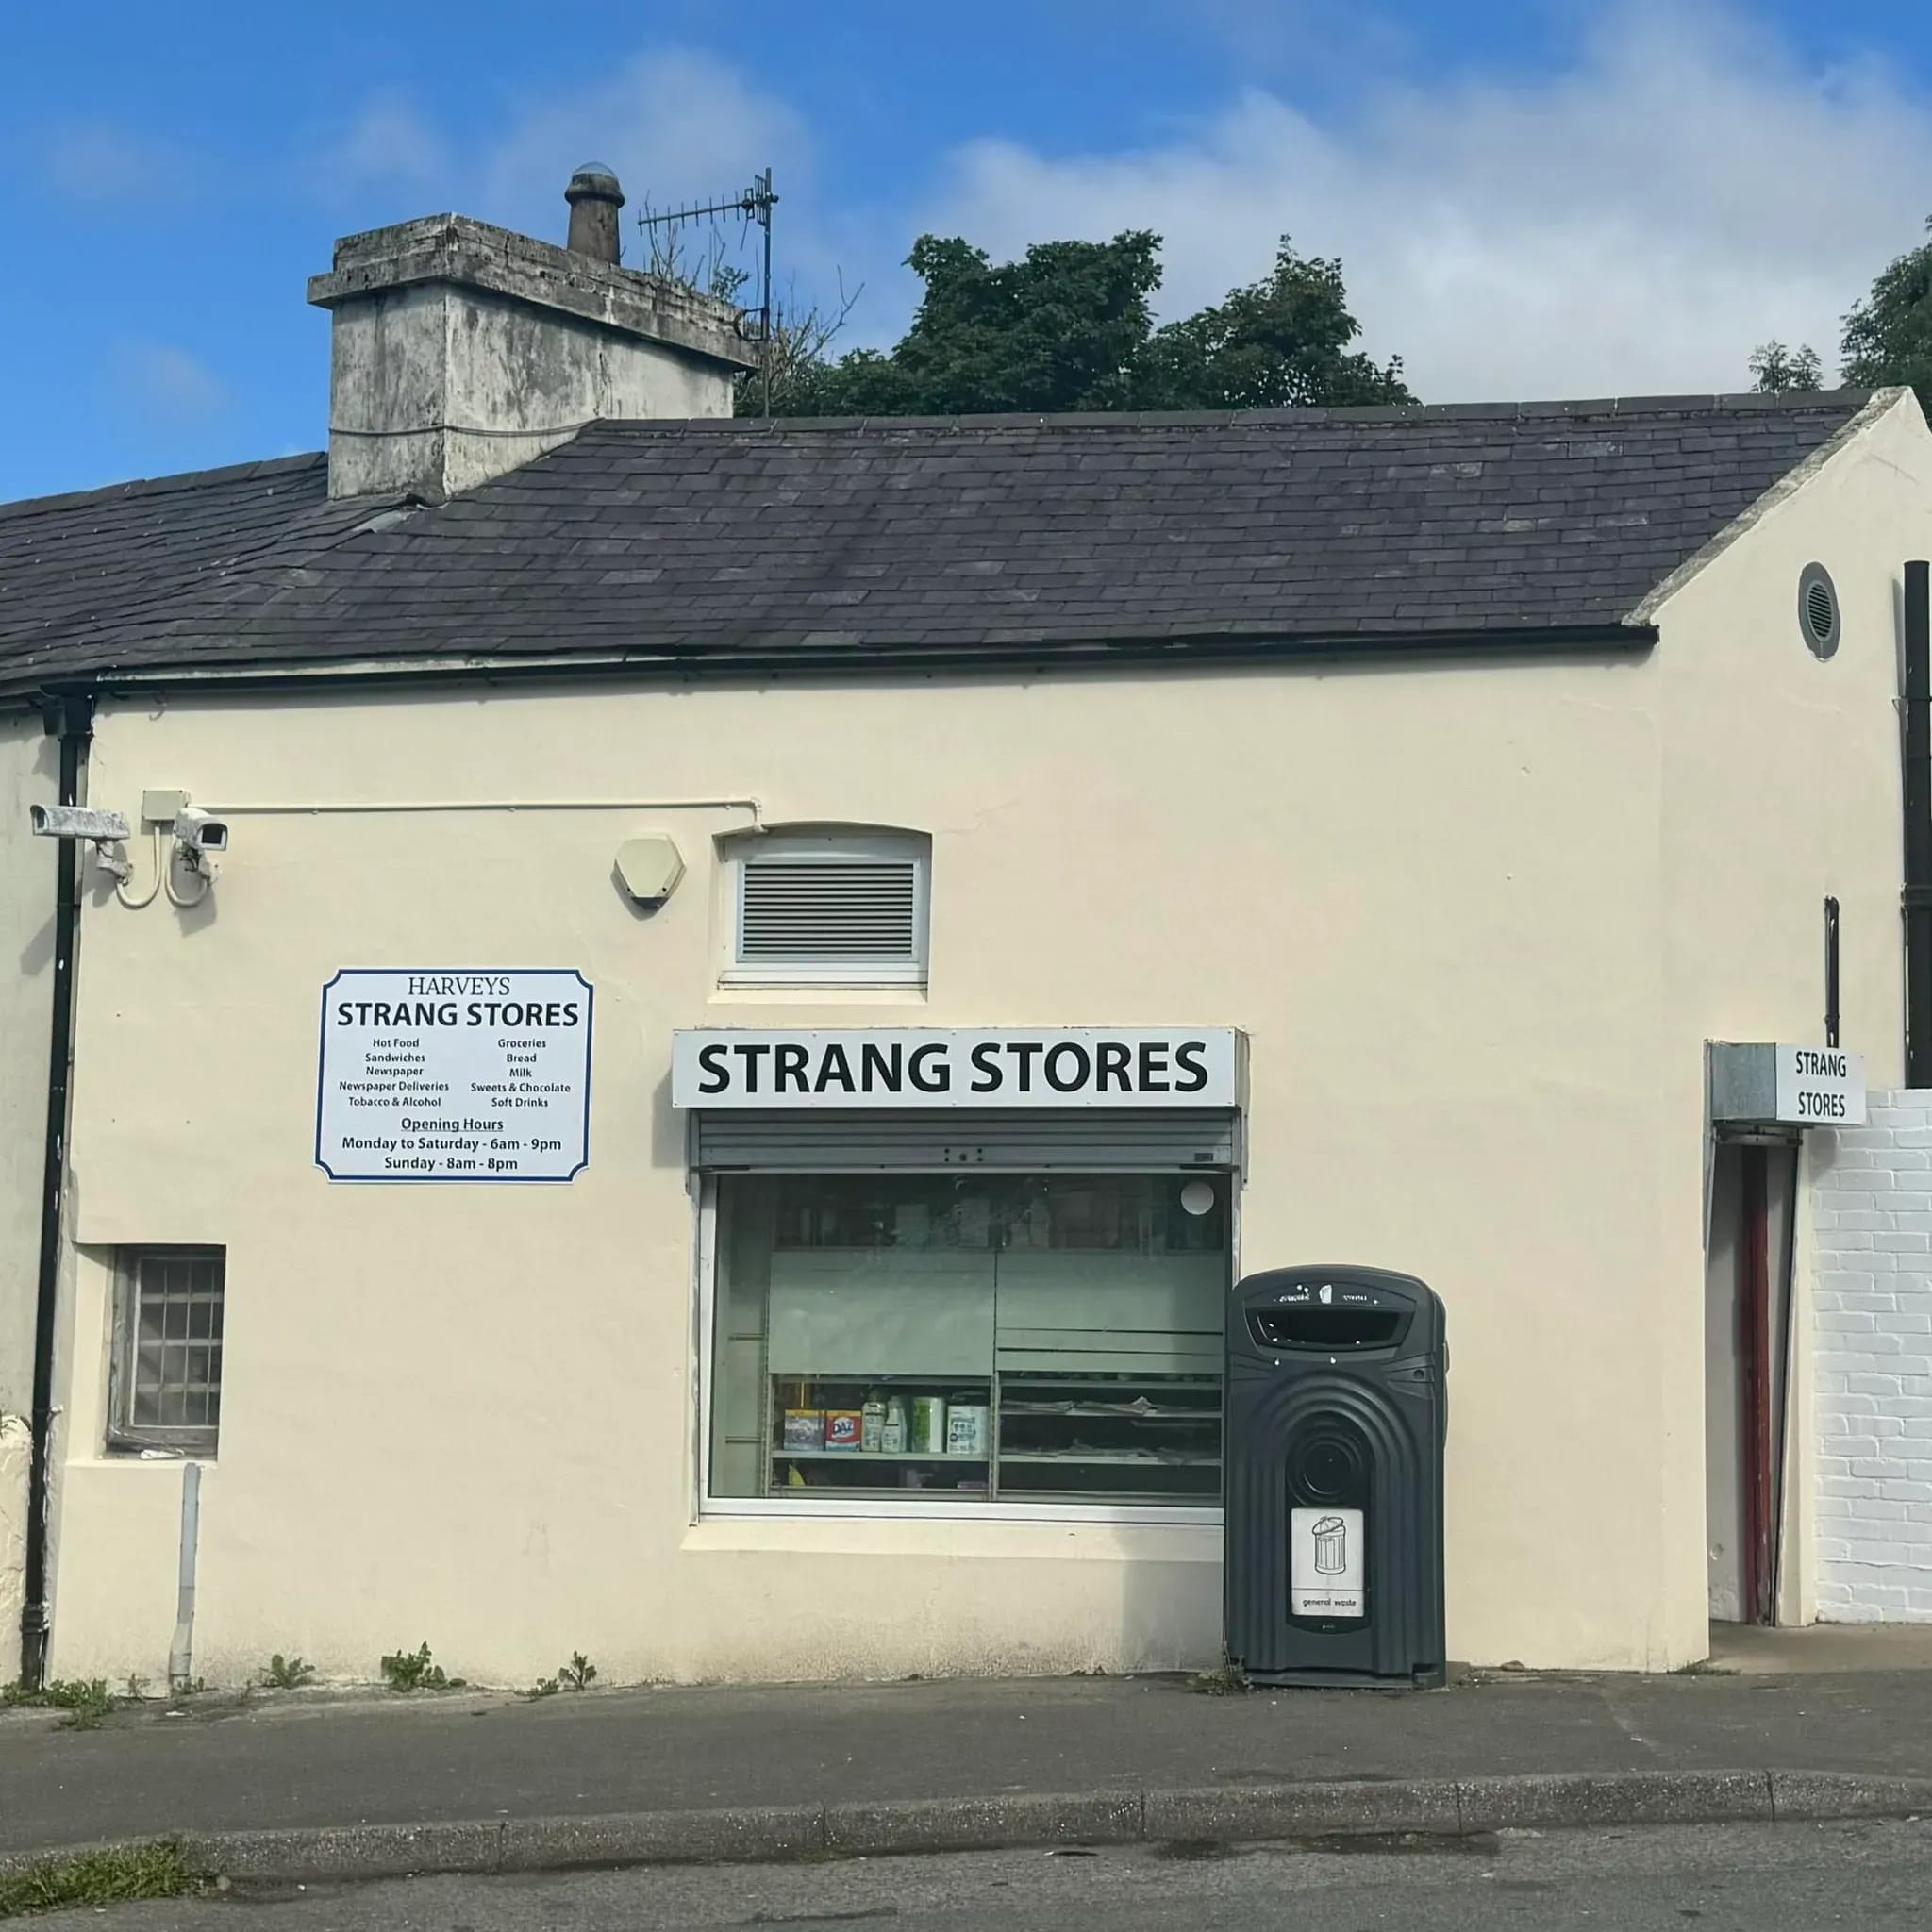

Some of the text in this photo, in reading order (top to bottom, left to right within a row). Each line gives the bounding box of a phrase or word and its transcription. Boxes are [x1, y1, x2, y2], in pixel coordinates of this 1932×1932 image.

[408, 977, 510, 995] HARVEYS
[338, 1003, 578, 1026] STRANG STORES
[373, 1039, 419, 1048] Hot Food
[498, 1039, 546, 1048] Groceries
[365, 1052, 425, 1062] Sandwiches
[507, 1053, 537, 1063] Bread
[697, 1041, 1208, 1093] STRANG STORES
[1796, 1051, 1846, 1077] STRANG
[366, 1066, 424, 1077] Newspaper
[509, 1068, 532, 1077] Milk
[339, 1081, 449, 1092] Newspaper Deliveries
[471, 1083, 571, 1092] Sweets & Chocolate
[349, 1096, 441, 1107] Tobacco & Alcohol
[491, 1097, 548, 1108] Soft Drinks
[1798, 1092, 1845, 1117] STORES
[401, 1118, 503, 1132] Opening Hours
[342, 1137, 397, 1152] Monday
[400, 1138, 415, 1149] to
[418, 1138, 479, 1153] Saturday
[491, 1139, 520, 1150] 6am
[531, 1140, 561, 1152] 9pm
[385, 1158, 436, 1172] Sunday
[446, 1158, 475, 1169] 8am
[489, 1158, 518, 1172] 8pm
